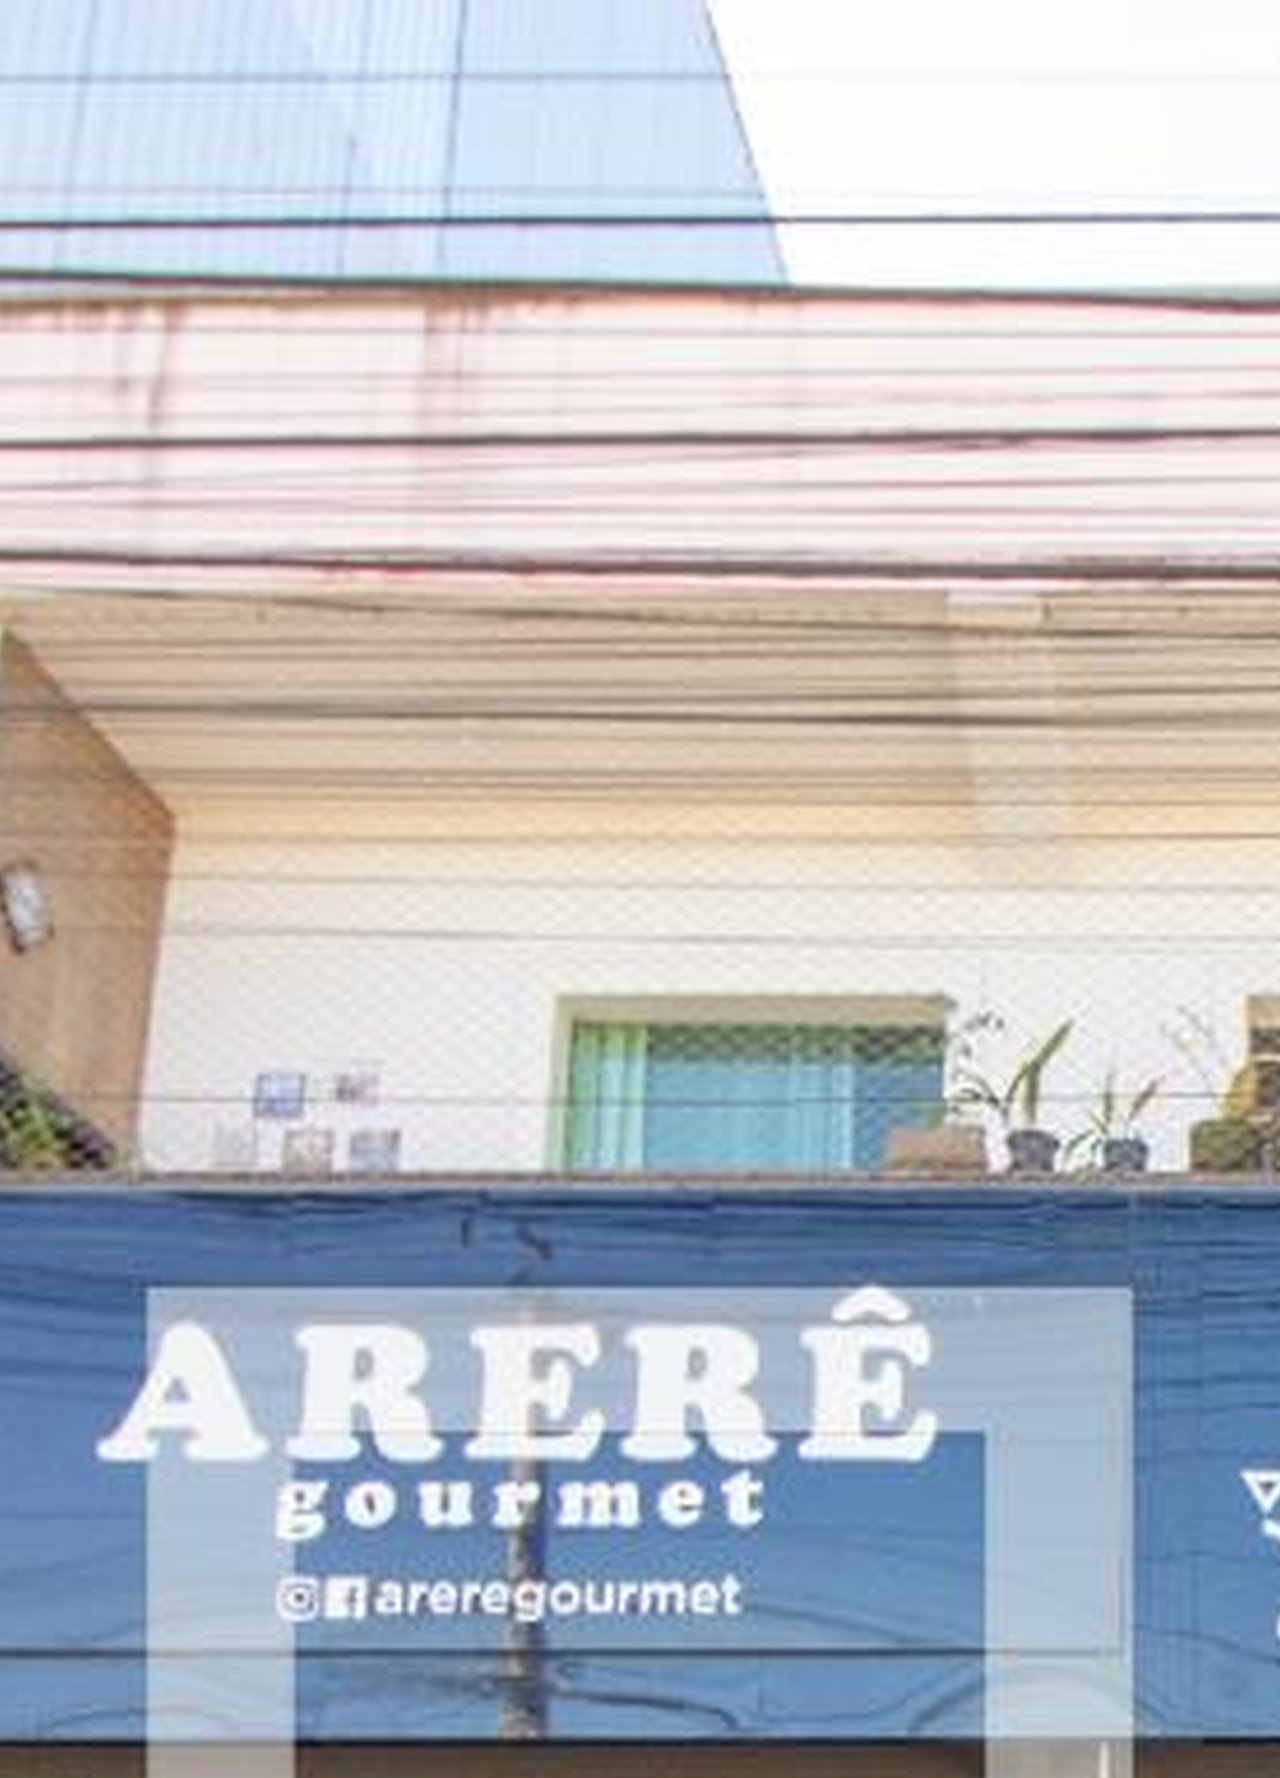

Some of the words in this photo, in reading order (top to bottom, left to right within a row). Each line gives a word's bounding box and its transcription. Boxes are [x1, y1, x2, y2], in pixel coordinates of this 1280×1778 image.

[96, 1285, 938, 1462] ARERÊ
[275, 1469, 765, 1540] gourmet
[372, 1573, 743, 1622] areregourmet
